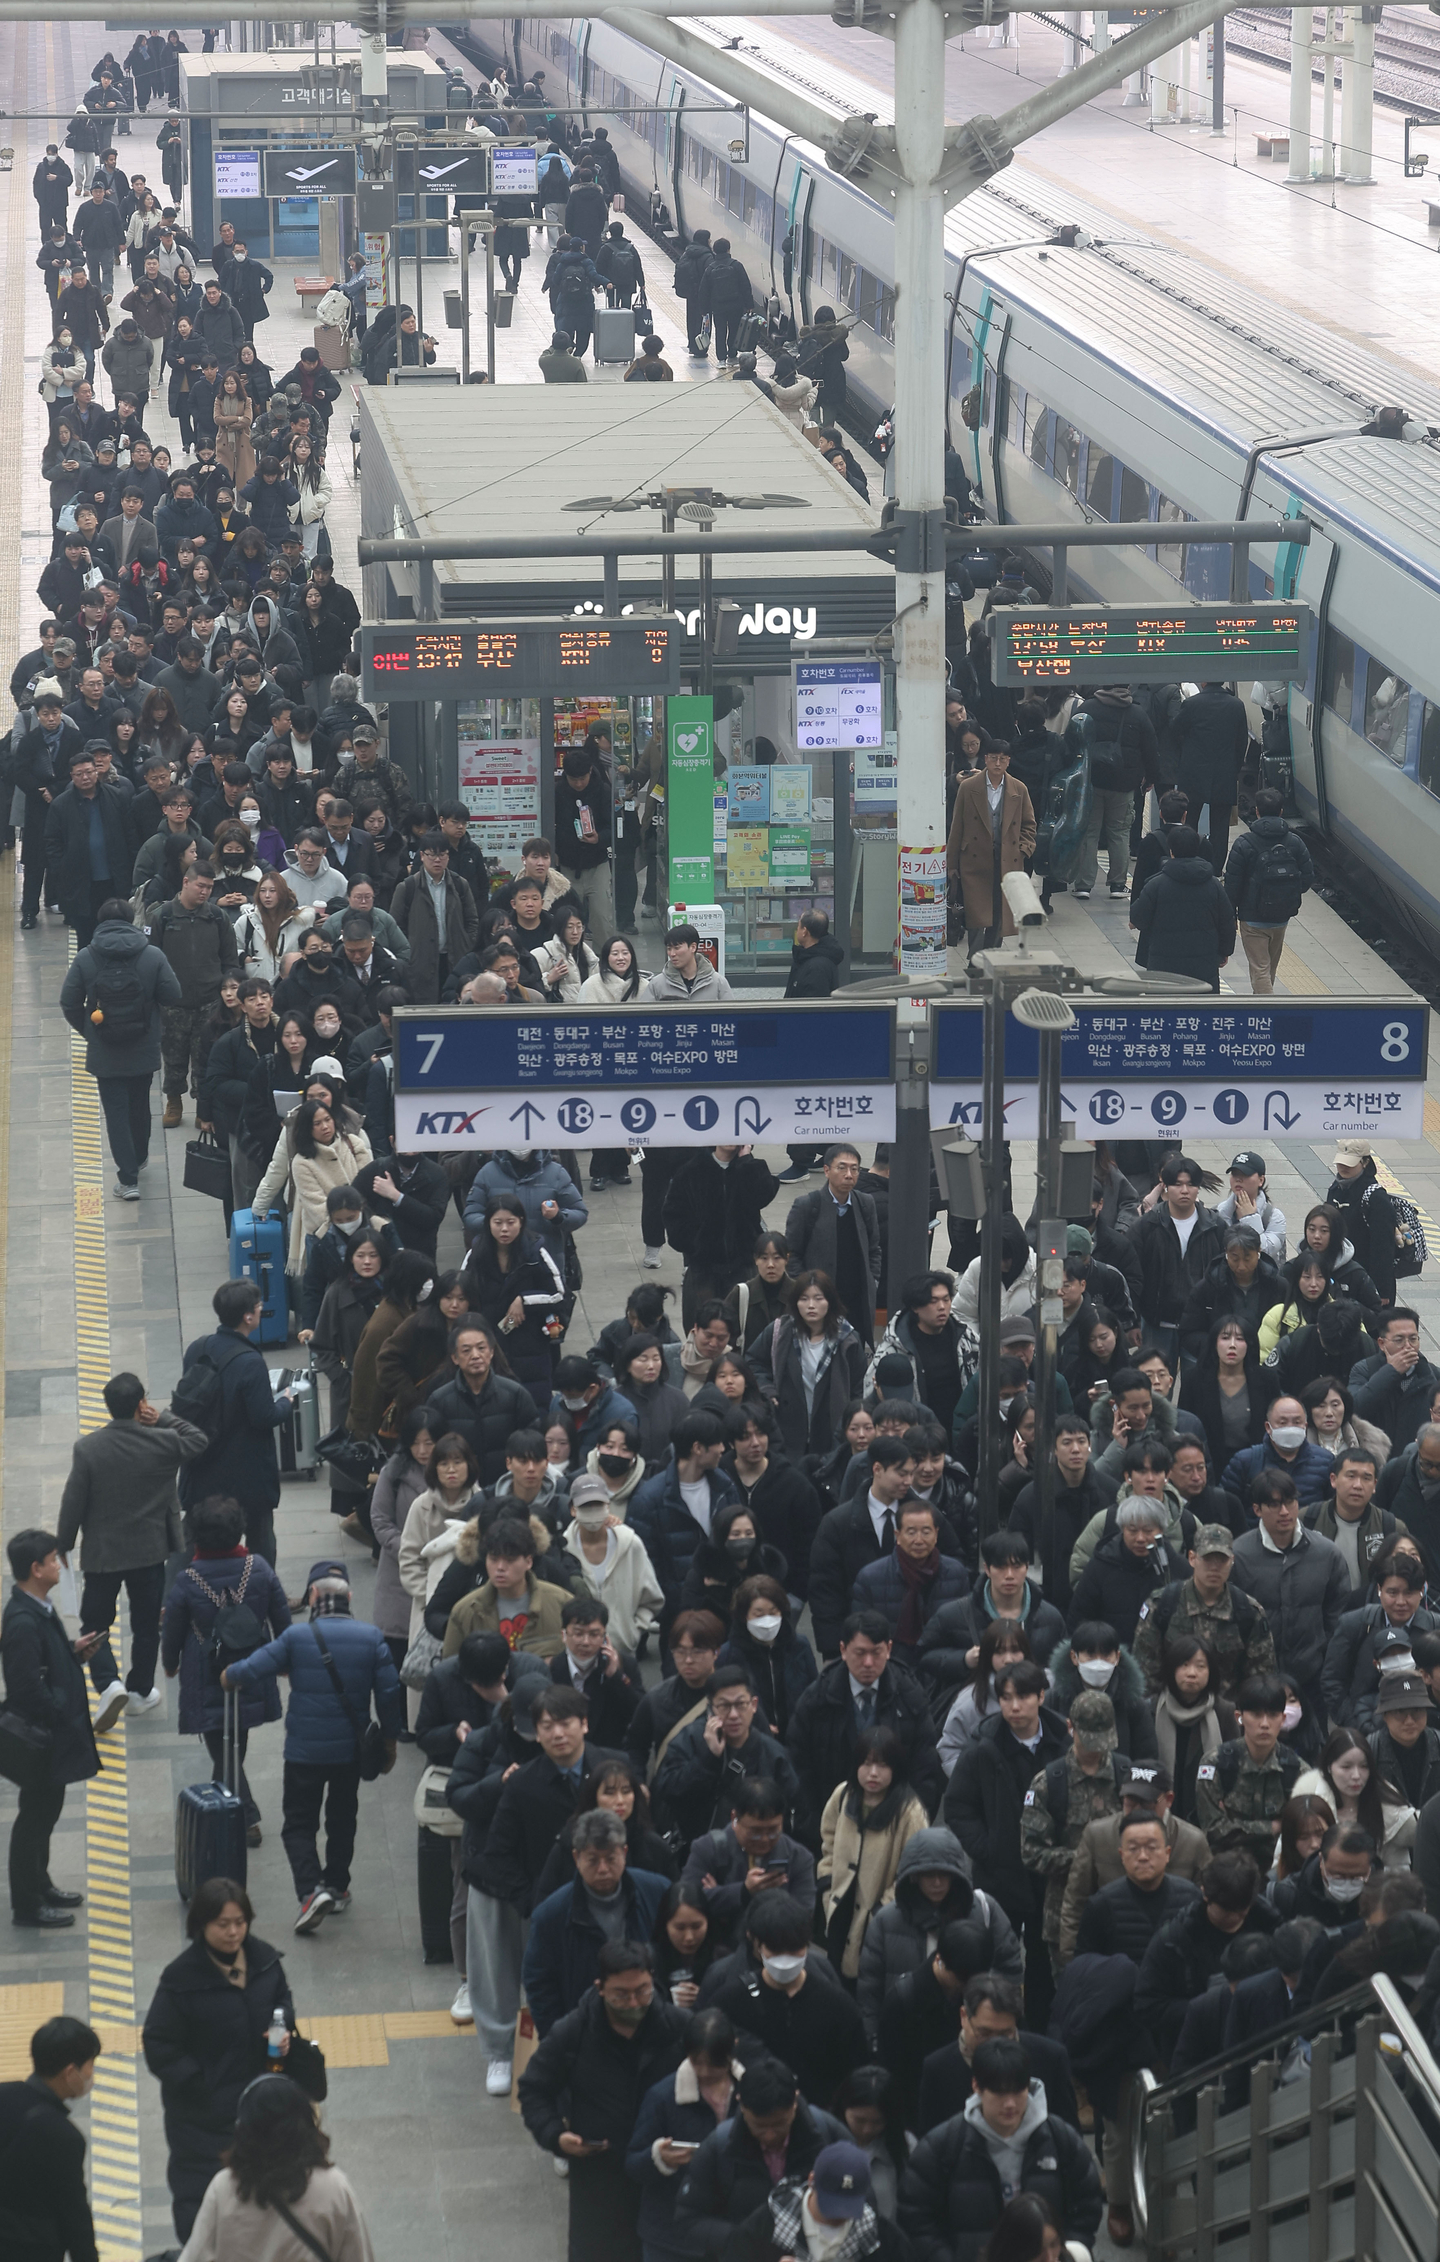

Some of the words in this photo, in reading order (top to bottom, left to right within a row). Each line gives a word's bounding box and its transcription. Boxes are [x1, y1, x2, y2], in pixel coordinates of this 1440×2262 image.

[282, 88, 351, 104] 고객대기실
[373, 652, 410, 670] 이번
[801, 668, 835, 679] 호차번호
[798, 688, 818, 696] KTX
[825, 707, 837, 715] 호차
[866, 736, 878, 744] 호차
[672, 759, 711, 767] 자동심장충격기
[868, 833, 897, 841] StoryW
[698, 939, 713, 949] ED
[1091, 1018, 1127, 1031] 동대구
[1140, 1018, 1164, 1031] 부산
[1176, 1018, 1200, 1031] 포항
[1212, 1018, 1235, 1031] 진주
[1248, 1018, 1272, 1031] 마산
[518, 1027, 542, 1041] 대전
[554, 1026, 590, 1041] 동대구
[602, 1026, 627, 1039] 부산
[638, 1025, 663, 1038] 포항
[675, 1024, 698, 1038] 진주
[711, 1024, 735, 1037] 마산
[1089, 1033, 1126, 1041] Dongdaegu
[1140, 1033, 1161, 1041] Busan
[1173, 1033, 1198, 1041] Pohang
[1218, 1033, 1235, 1041] Jinju
[553, 1042, 590, 1050] Dongdaegu
[638, 1040, 663, 1048] Pohang
[676, 1040, 692, 1048] Jinju
[1379, 1021, 1411, 1063] 8
[415, 1033, 445, 1075] 7
[1088, 1044, 1111, 1058] 익산
[1123, 1044, 1171, 1058] 광주송정
[1183, 1044, 1206, 1057] 목포
[1219, 1044, 1276, 1057] 여수EXPO
[1282, 1044, 1306, 1057] 방면
[518, 1054, 542, 1067] 익산
[554, 1053, 602, 1066] 광주송정
[614, 1052, 638, 1064] 목포
[650, 1051, 708, 1064] 여수EXPO
[714, 1050, 738, 1064] 방면
[1182, 1059, 1206, 1067] Mokpo
[1255, 1059, 1272, 1067] Expo
[518, 1069, 537, 1077] Iksan
[614, 1067, 638, 1076] Mokpo
[650, 1067, 673, 1075] Yeosu
[673, 1067, 692, 1075] Expo
[794, 1096, 874, 1119] 호차번호
[1090, 1095, 1124, 1120] 18
[1161, 1096, 1177, 1120] 9
[1322, 1092, 1402, 1114] 호차번호
[415, 1106, 495, 1135] KTX
[559, 1103, 592, 1129] 18
[630, 1104, 646, 1129] 9
[794, 1125, 811, 1136] Car
[813, 1124, 851, 1136] number
[1322, 1121, 1338, 1131] Car
[1340, 1121, 1379, 1131] number
[1157, 1129, 1180, 1139] 현위치
